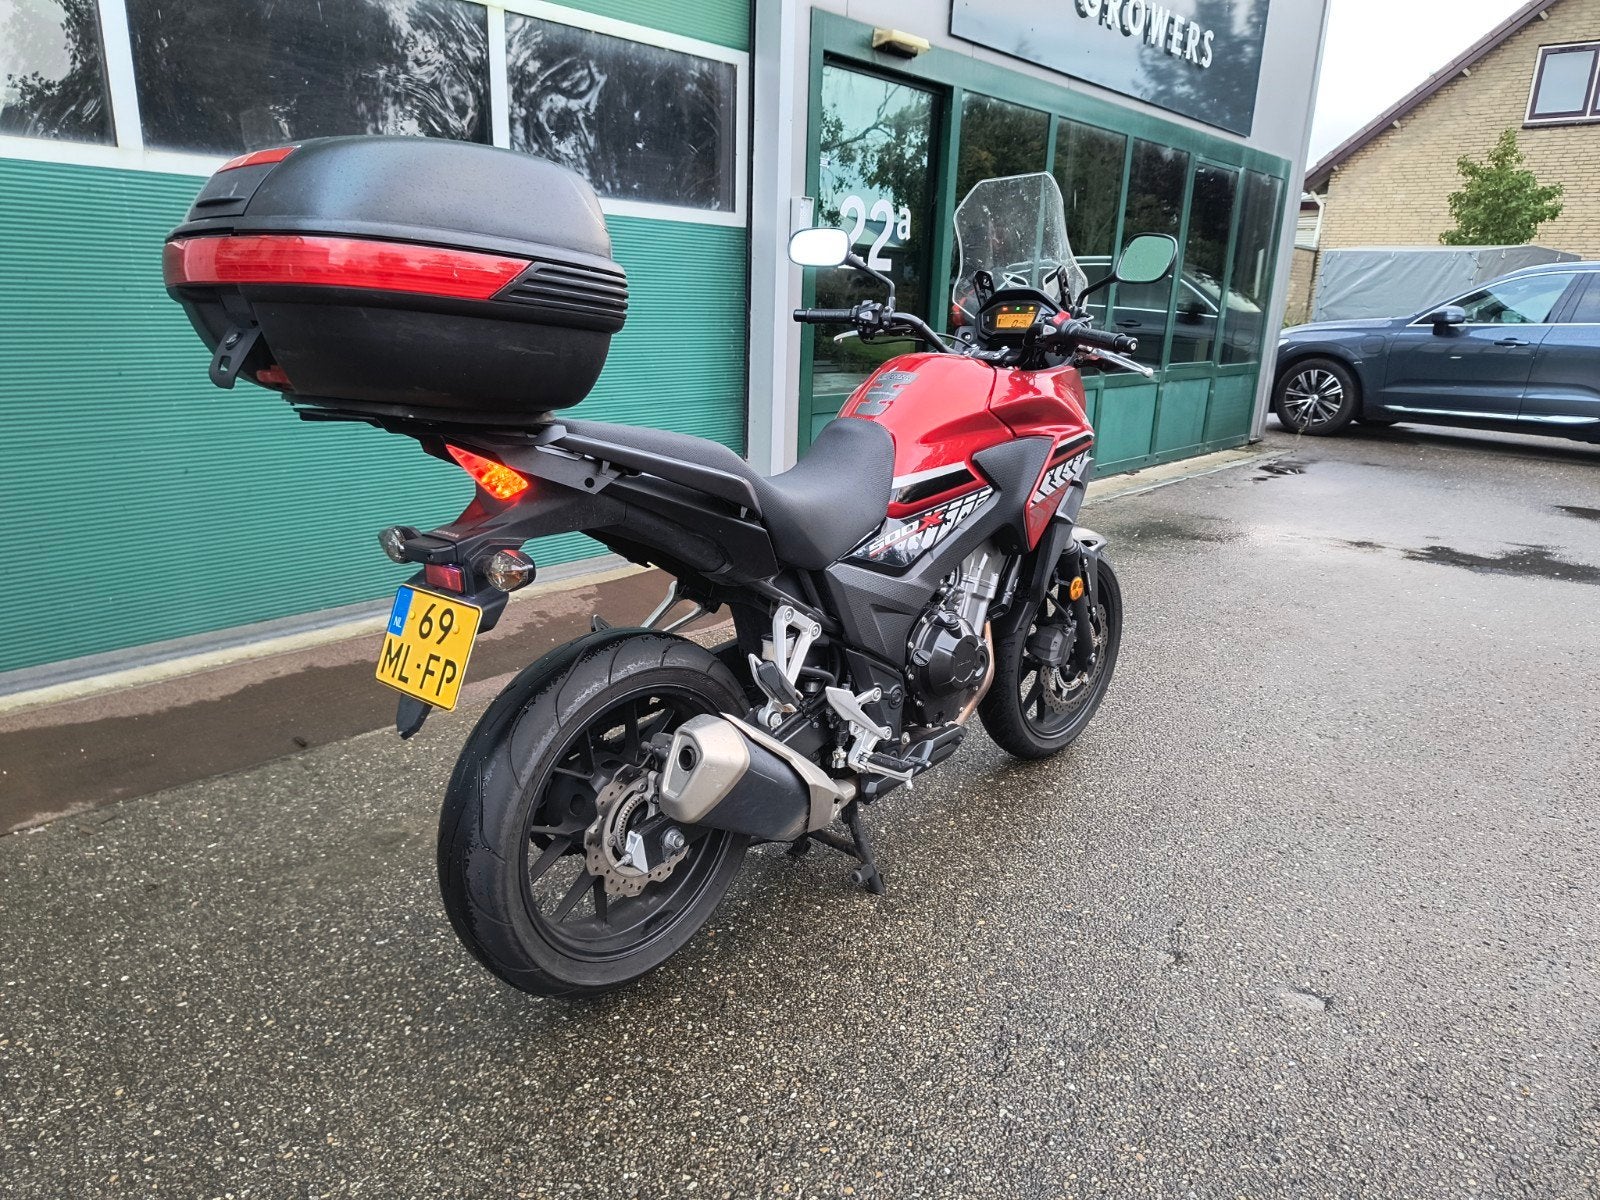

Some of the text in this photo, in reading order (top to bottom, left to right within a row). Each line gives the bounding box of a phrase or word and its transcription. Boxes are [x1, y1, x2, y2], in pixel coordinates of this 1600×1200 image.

[838, 195, 912, 271] 22a
[392, 616, 402, 628] NL
[418, 603, 455, 645] 69
